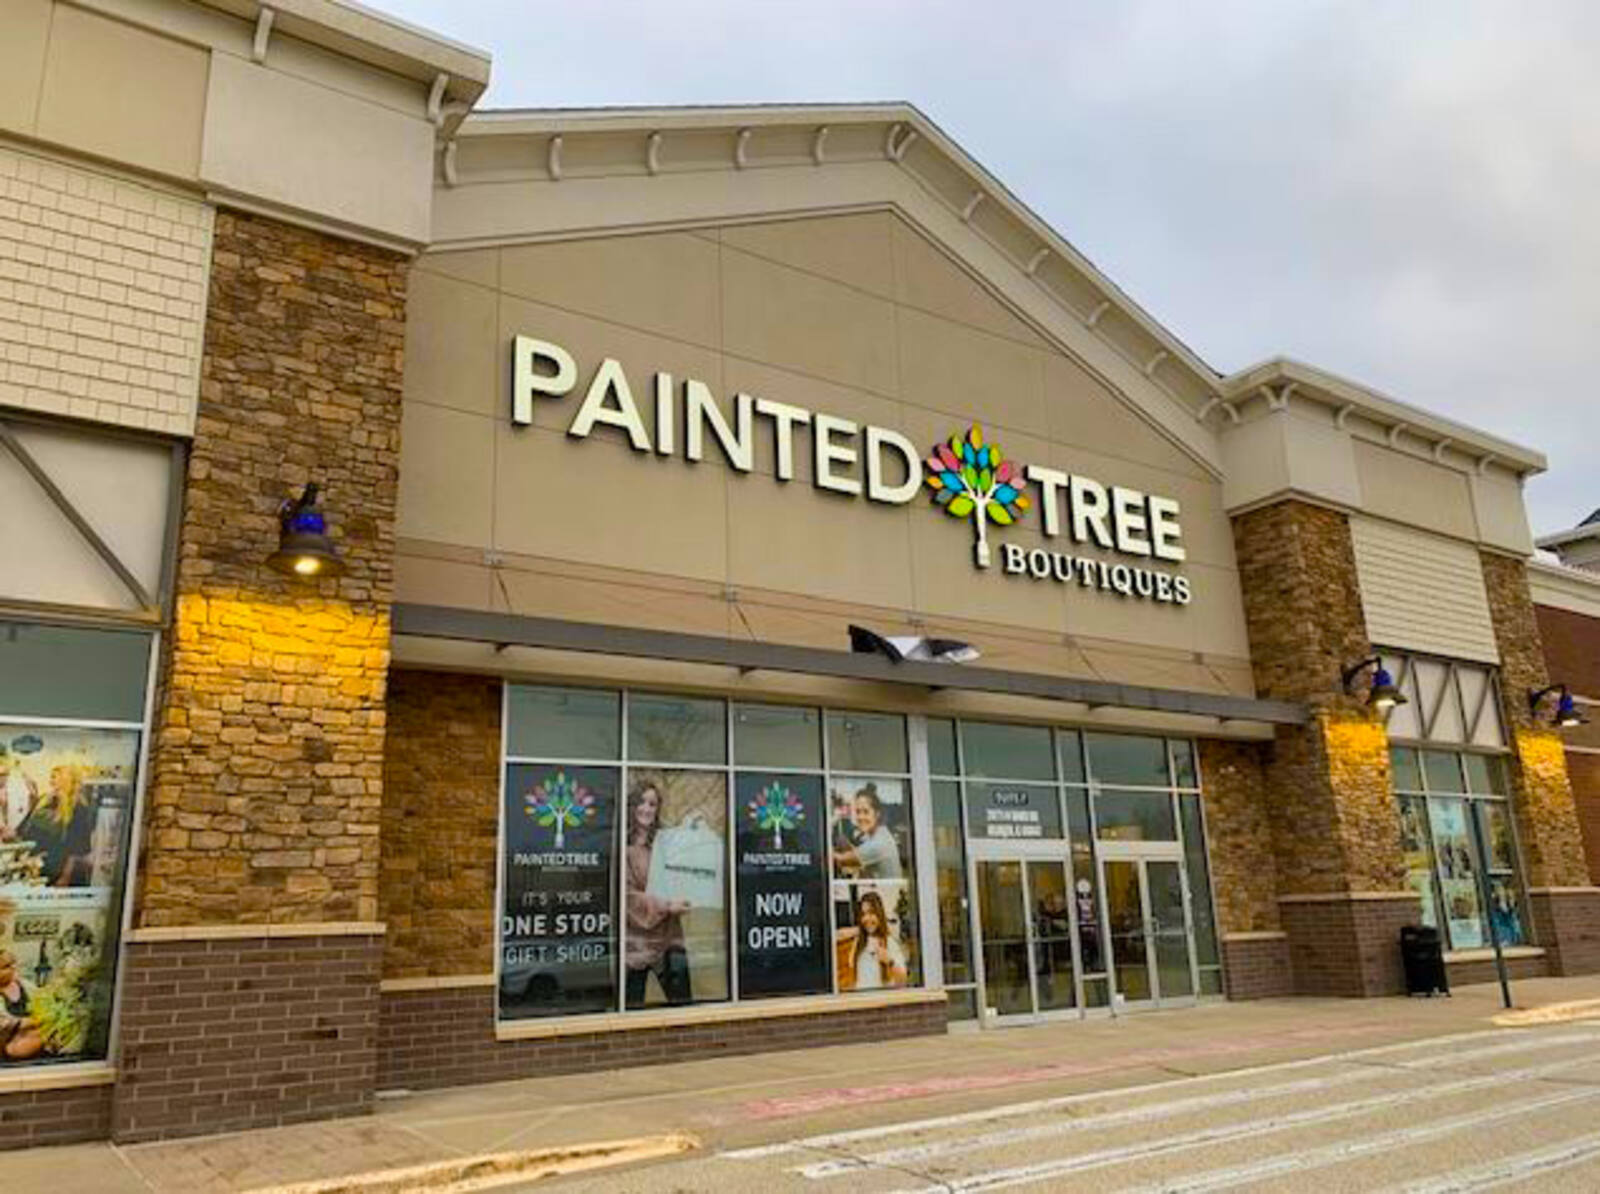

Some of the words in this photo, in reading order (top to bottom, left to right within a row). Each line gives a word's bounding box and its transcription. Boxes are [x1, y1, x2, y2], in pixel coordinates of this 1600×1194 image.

[511, 334, 923, 505] PAINTED
[1025, 465, 1187, 562] TREE
[1003, 543, 1192, 605] BOUTIQUES
[557, 890, 594, 905] YOUR
[756, 892, 803, 917] NOW
[502, 914, 548, 936] ONE
[555, 913, 611, 935] STOP
[748, 925, 812, 950] OPEN!
[506, 945, 548, 966] GIFT
[557, 943, 606, 963] SHOP
